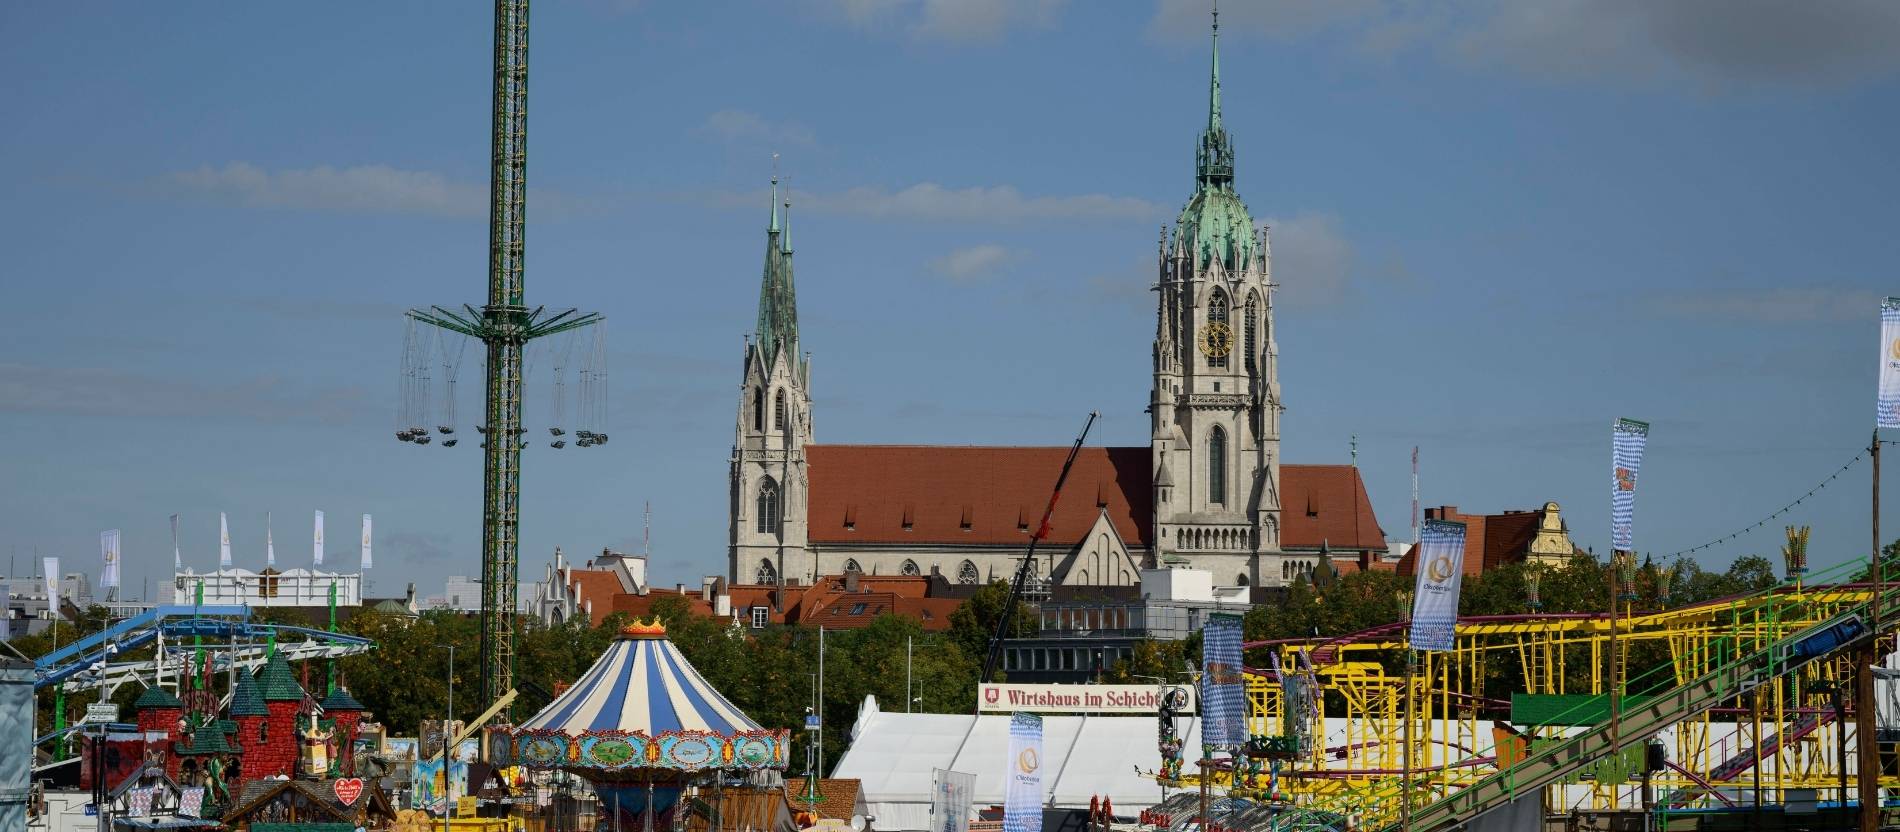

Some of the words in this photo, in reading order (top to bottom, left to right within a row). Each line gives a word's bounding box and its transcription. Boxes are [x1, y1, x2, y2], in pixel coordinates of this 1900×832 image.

[1008, 689, 1081, 708] Wirtshaus
[1084, 691, 1103, 708] im
[1106, 690, 1162, 709] Schicht
